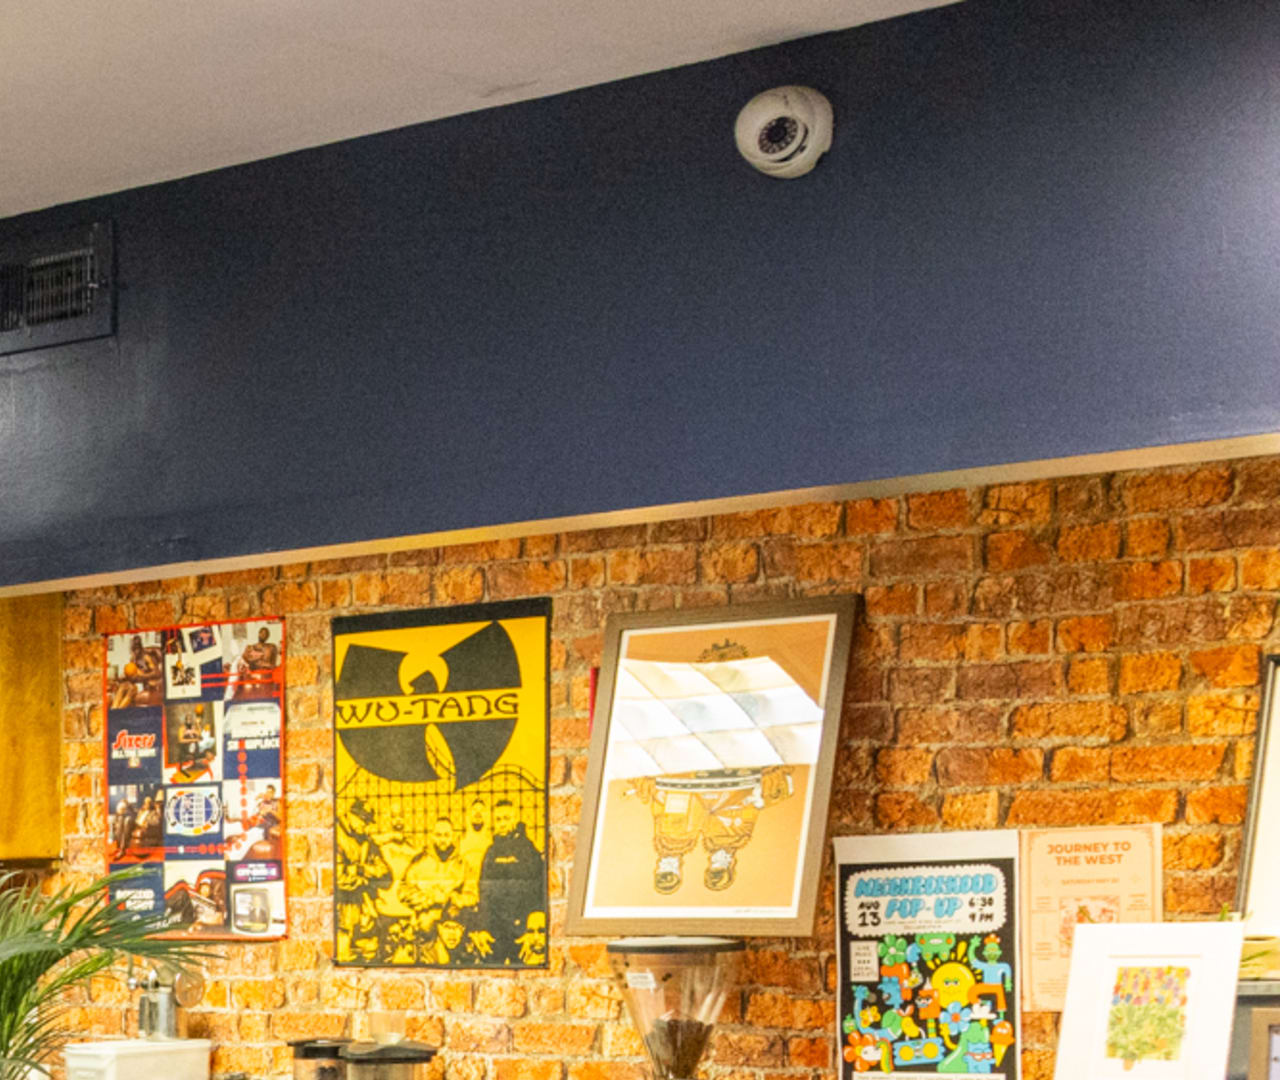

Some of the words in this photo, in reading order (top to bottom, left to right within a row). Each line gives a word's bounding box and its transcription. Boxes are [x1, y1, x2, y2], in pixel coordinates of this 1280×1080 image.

[339, 693, 519, 724] WU-TANG
[1047, 842, 1109, 855] JOURNEY
[1112, 840, 1132, 852] TO
[1055, 855, 1081, 866] THE
[1084, 853, 1124, 865] WEST
[858, 911, 881, 927] 13
